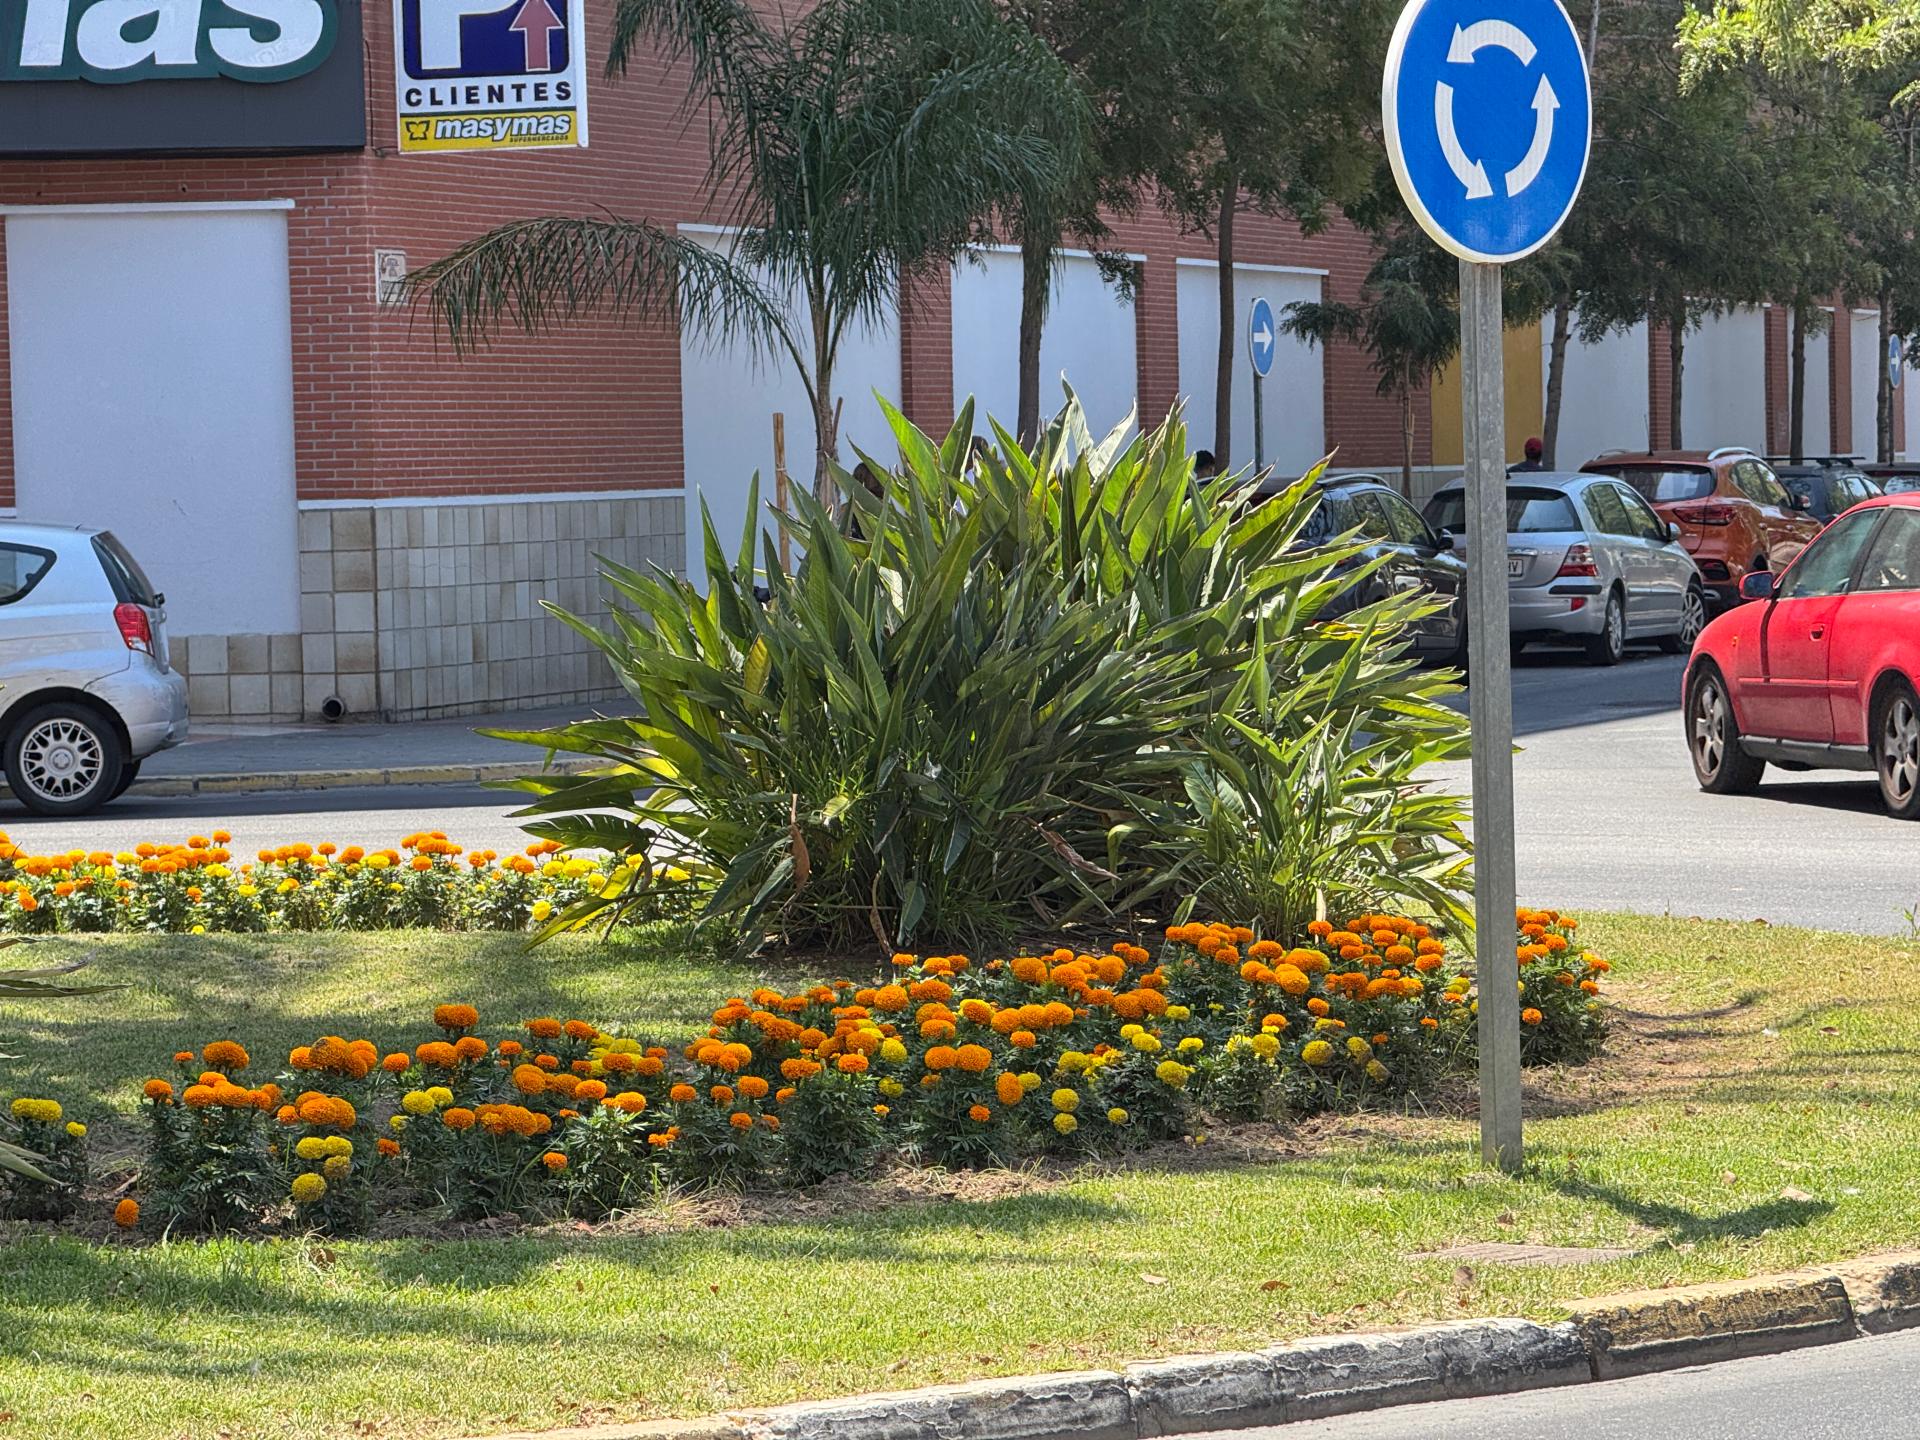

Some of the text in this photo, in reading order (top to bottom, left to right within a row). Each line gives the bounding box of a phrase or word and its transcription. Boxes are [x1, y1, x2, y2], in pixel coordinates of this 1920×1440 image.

[20, 0, 323, 70] as
[405, 81, 571, 107] CLIENTES
[434, 115, 571, 142] masymas
